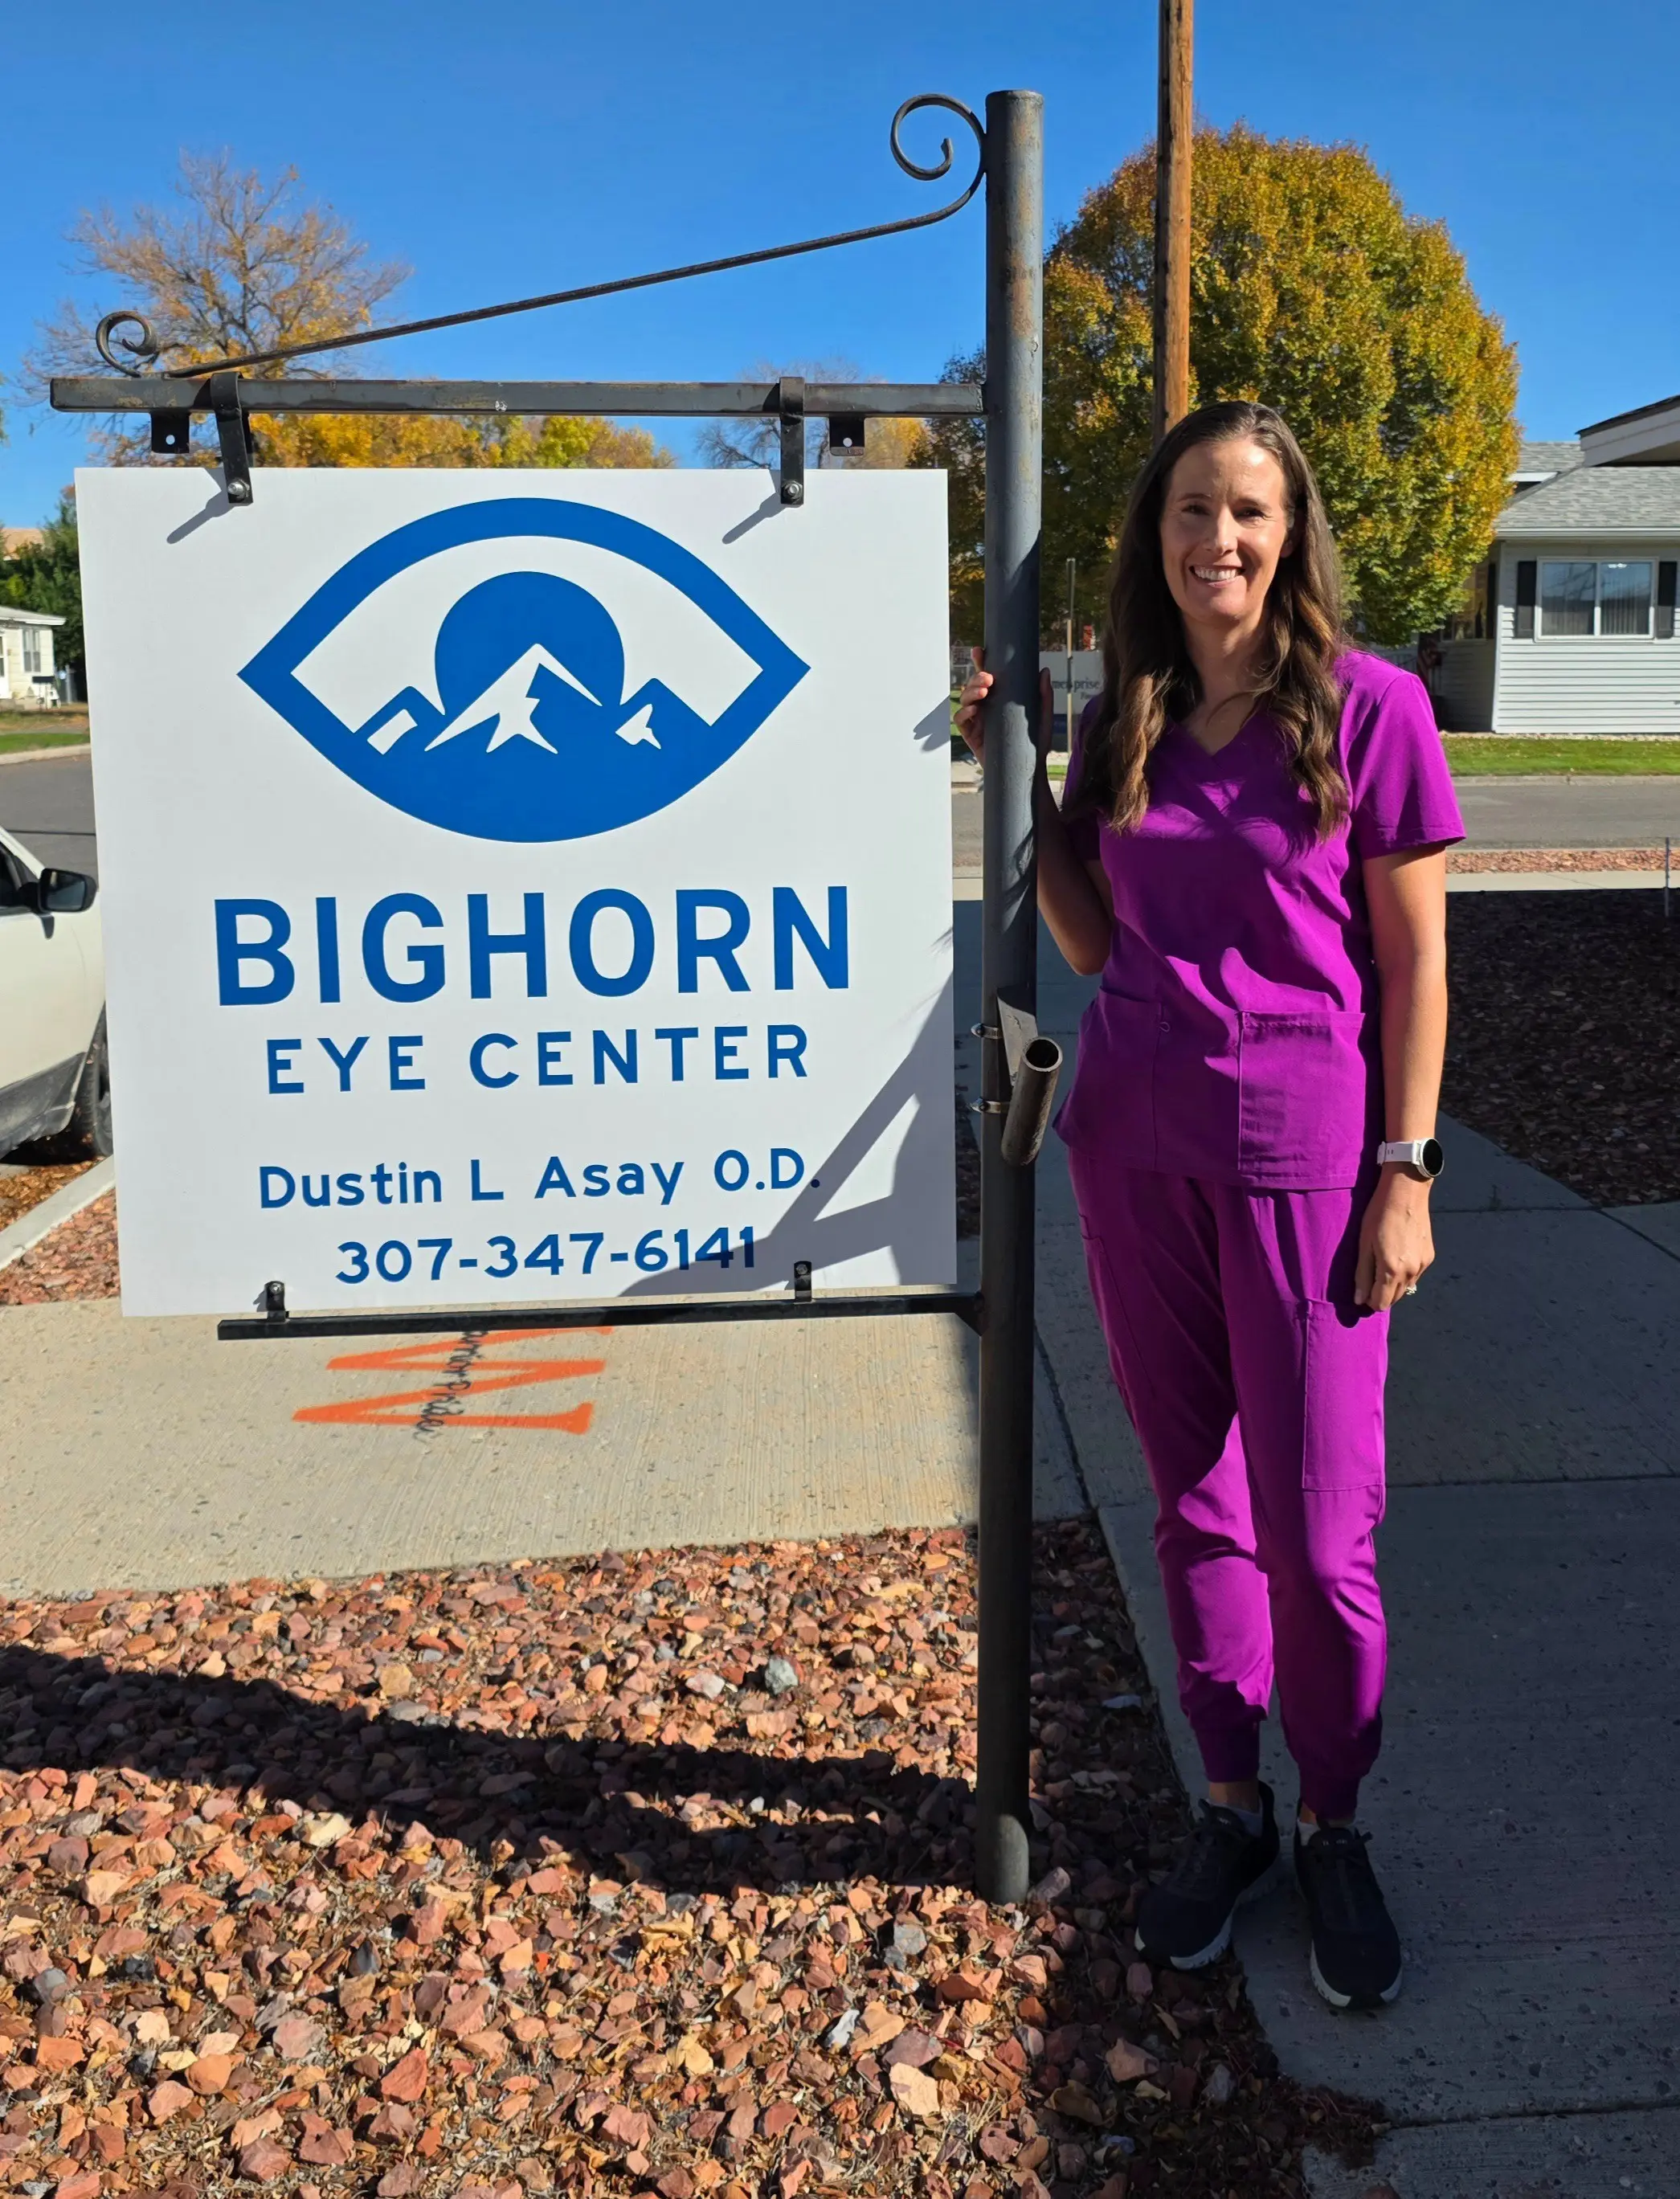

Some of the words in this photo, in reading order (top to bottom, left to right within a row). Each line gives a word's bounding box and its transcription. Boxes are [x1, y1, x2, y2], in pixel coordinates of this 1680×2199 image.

[214, 885, 851, 1007] BIGHORN
[266, 1034, 427, 1095] EYE
[468, 1024, 809, 1089] CENTER
[259, 1162, 443, 1209] Dustin
[470, 1159, 505, 1202] L
[534, 1155, 685, 1207] Asay
[713, 1147, 820, 1192] O.D.
[336, 1224, 755, 1285] 307-347-6141
